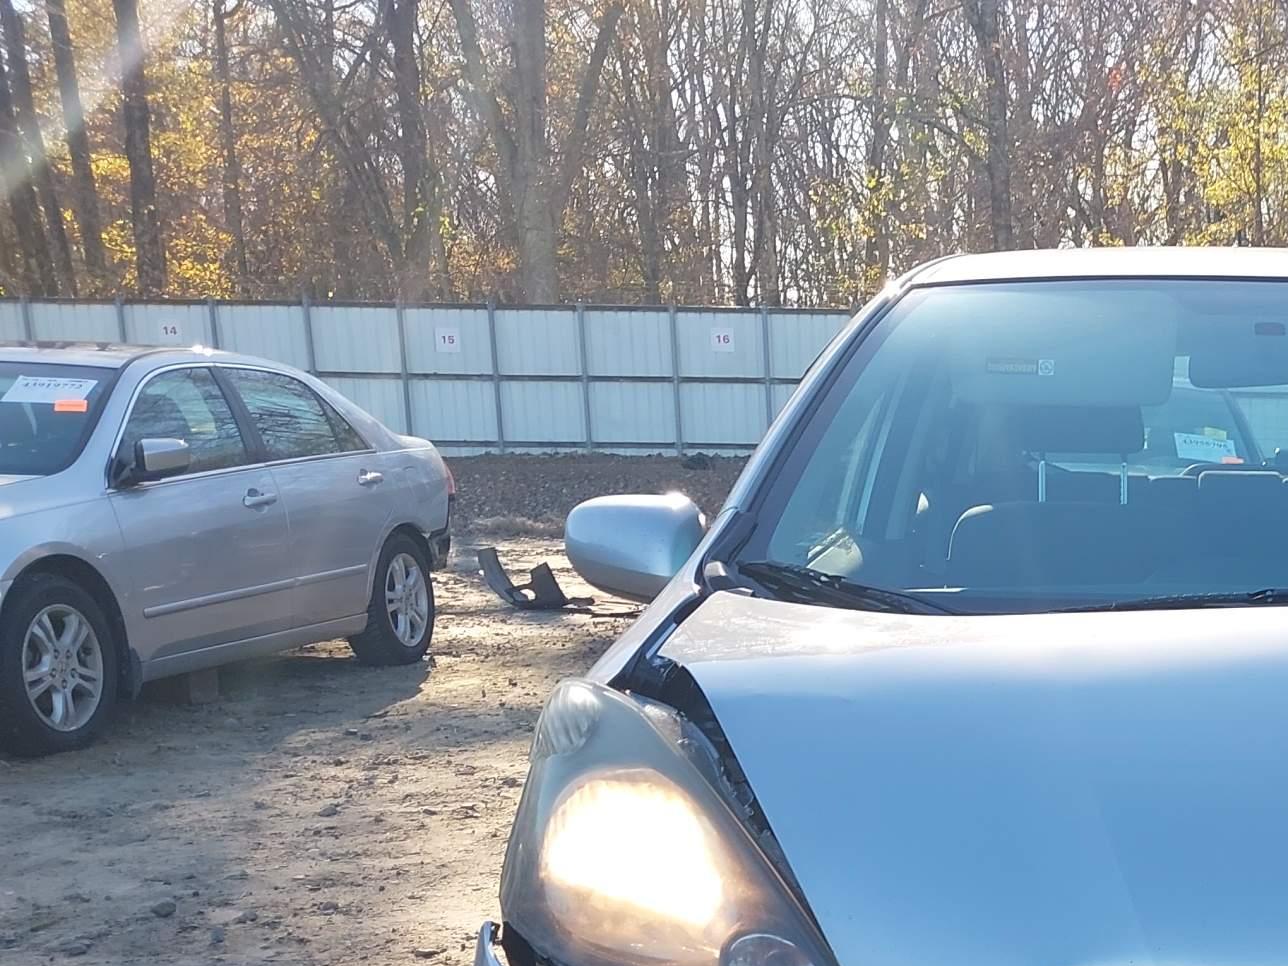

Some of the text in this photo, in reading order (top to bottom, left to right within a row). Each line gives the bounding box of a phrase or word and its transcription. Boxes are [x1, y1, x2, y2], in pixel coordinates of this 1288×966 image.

[162, 326, 177, 336] 14
[441, 335, 455, 345] 15
[715, 334, 730, 345] 16
